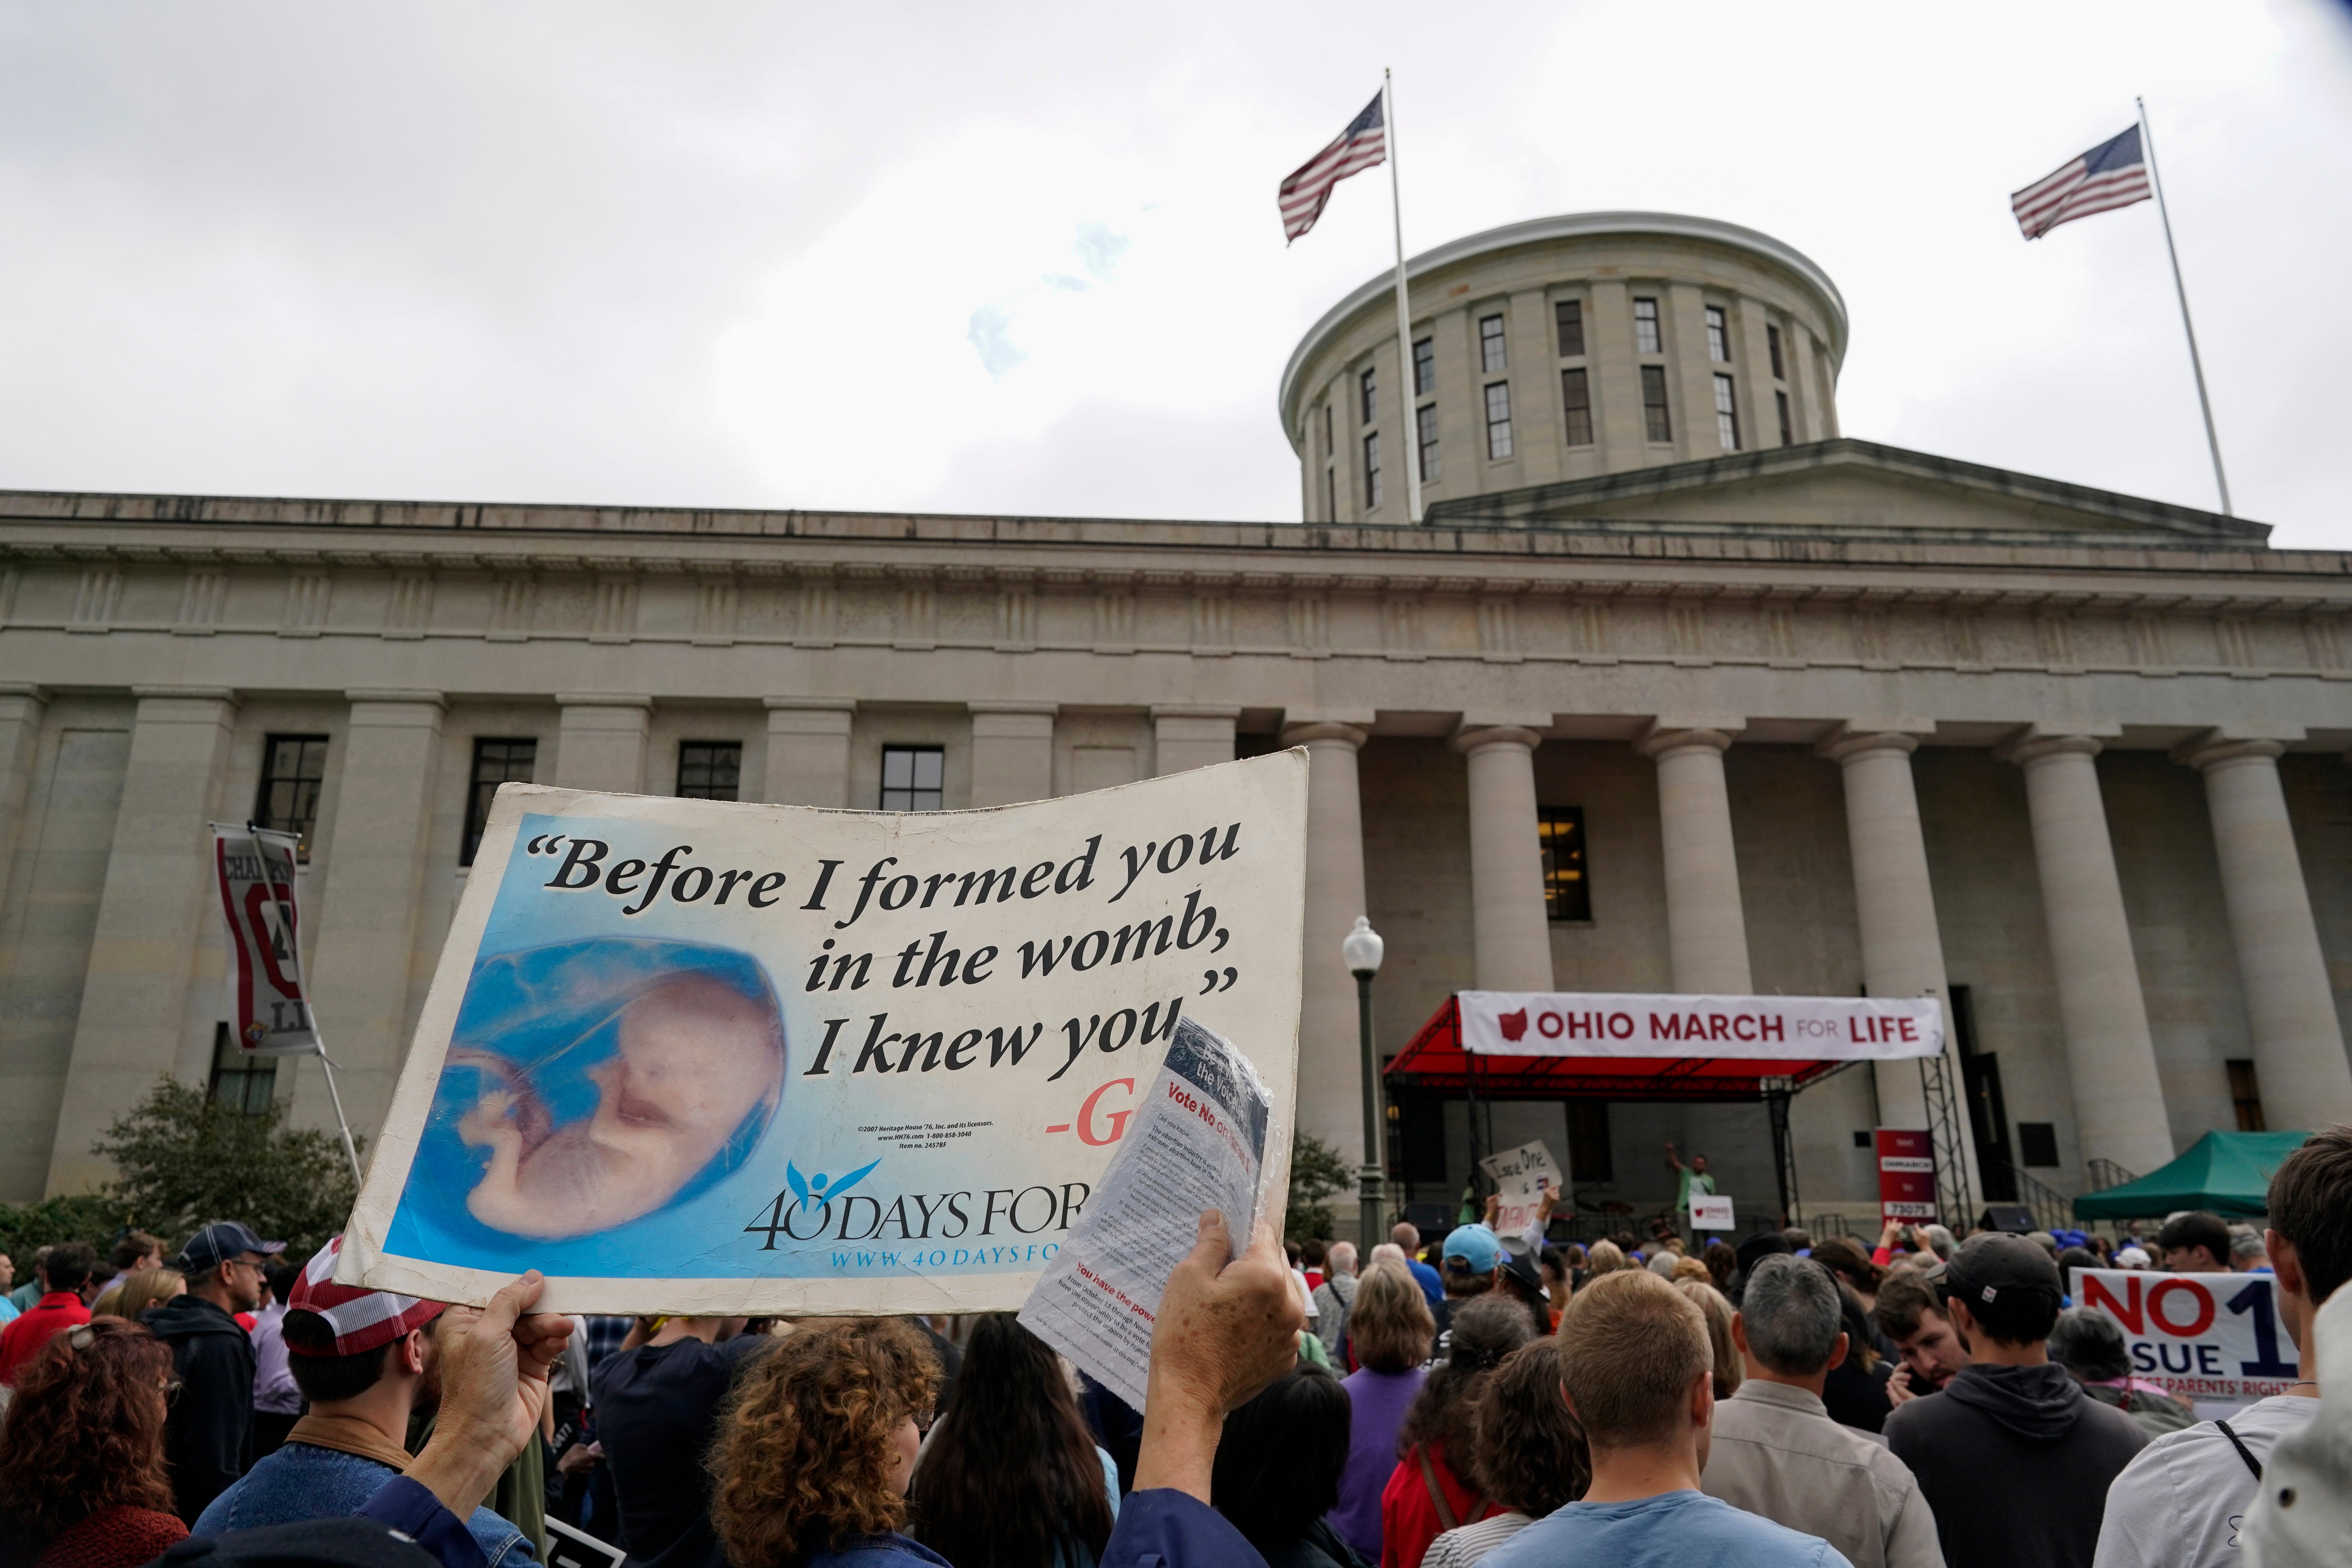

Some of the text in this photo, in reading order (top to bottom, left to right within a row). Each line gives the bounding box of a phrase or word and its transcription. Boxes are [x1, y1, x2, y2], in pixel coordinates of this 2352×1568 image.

[527, 822, 1241, 930] “Before I formed you
[805, 889, 1230, 992] in the womb,
[803, 1019, 849, 1076] I
[852, 1012, 1042, 1073] knew
[1537, 1010, 1919, 1044] OHIO MARCH FOR LIFE
[1197, 1063, 1214, 1085] the
[1045, 1077, 1136, 1146] -G
[1169, 1082, 1215, 1125] Vote No
[927, 1131, 972, 1139] 1-800-858-3040
[1152, 1125, 1162, 1134] The
[1162, 1132, 1183, 1148] abortion
[1183, 1145, 1203, 1162] industry
[1158, 1114, 1192, 1140] Did you know...
[1148, 1133, 1169, 1149] extreme
[1169, 1147, 1190, 1163] abortion
[1190, 1160, 1201, 1171] laws
[1206, 1171, 1214, 1180] the
[1168, 1160, 1193, 1178] Constitutional
[1130, 1194, 1142, 1204] health
[1149, 1207, 1160, 1217] safety
[1133, 1187, 1170, 1214] Eliminate Ohio's laws
[1142, 1172, 1152, 1181] Allow
[1152, 1180, 1174, 1195] abortionists
[1178, 1196, 1192, 1207] perform
[1154, 1187, 1173, 1203] knowledge
[1178, 1205, 1192, 1216] consent.
[743, 1182, 1090, 1250] 40 DAYS FOR
[1124, 1203, 1135, 1212] Allow
[1161, 1229, 1176, 1240] perform
[1129, 1216, 1143, 1227] months
[1133, 1239, 1148, 1252] because
[1136, 1251, 1162, 1270] ability have
[1077, 1261, 1132, 1306] You have the
[1109, 1254, 1120, 1263] could
[1125, 1266, 1141, 1278] enacted
[1113, 1248, 1129, 1261] because
[1136, 1265, 1149, 1274] would
[1148, 1273, 1162, 1283] amend
[1058, 1279, 1071, 1292] have
[1071, 1288, 1081, 1299] the
[1081, 1297, 1113, 1323] opportunity
[1113, 1318, 1120, 1326] to
[1120, 1323, 1128, 1332] be
[1132, 1333, 1145, 1344] vote
[1067, 1275, 1134, 1325] From October 11 through
[2083, 1274, 2215, 1338] NO
[1072, 1302, 1130, 1347] protect the unborn by
[2132, 1281, 2299, 1378] SUE 1
[1035, 1314, 1043, 1323] Paid
[1052, 1327, 1064, 1338] Center
[1069, 1339, 1084, 1353] Christian
[1103, 1365, 1122, 1381] authorized
[1086, 1326, 1100, 1339] Learn
[1100, 1338, 1112, 1348] more
[1118, 1351, 1148, 1374] ccv.org/vote
